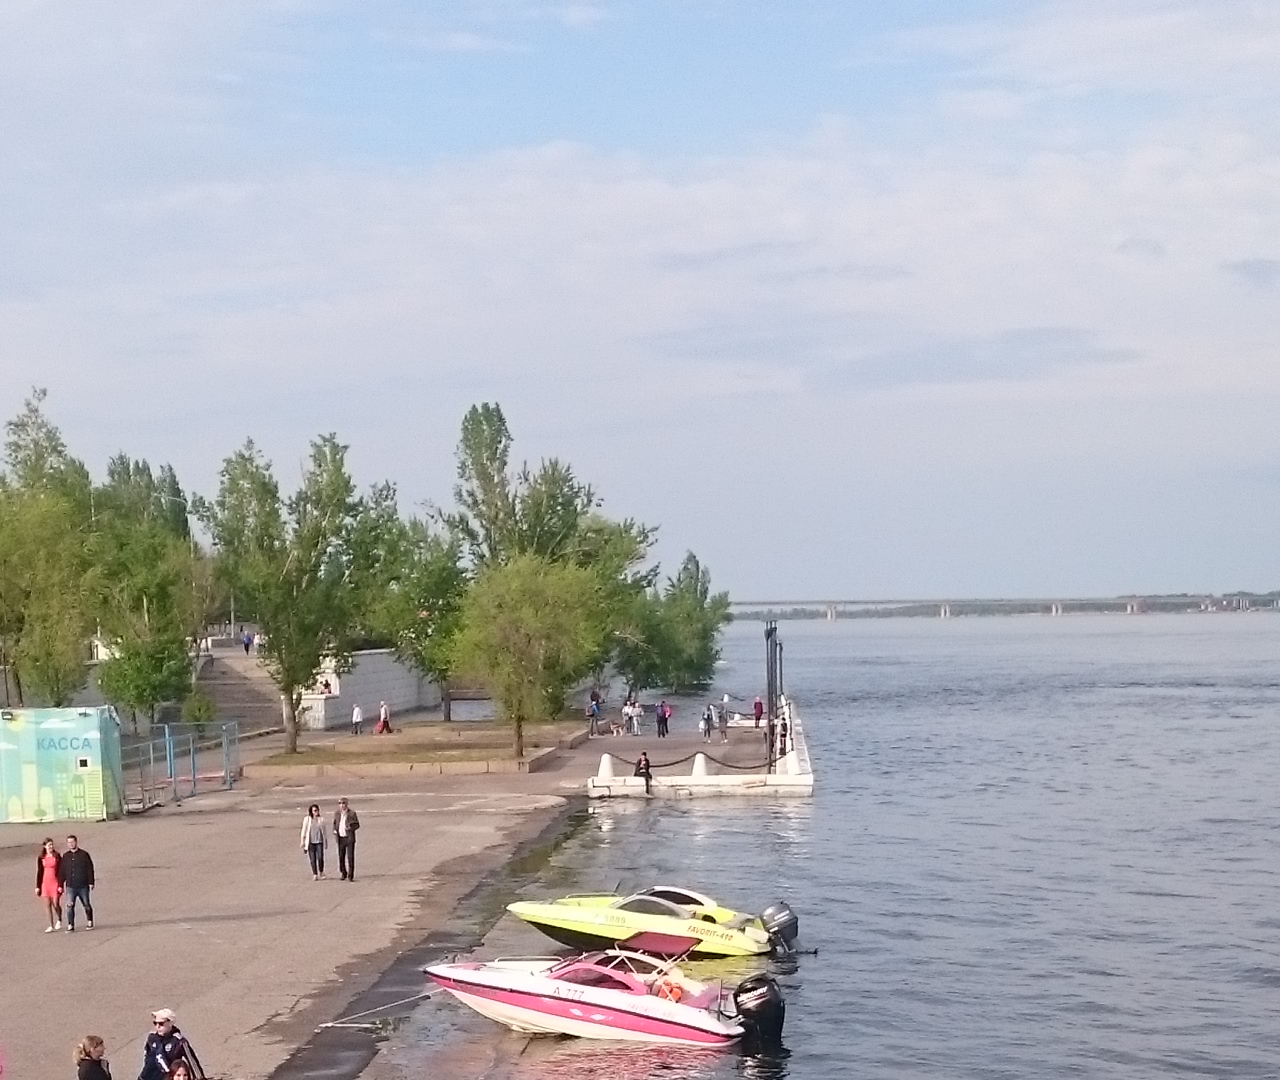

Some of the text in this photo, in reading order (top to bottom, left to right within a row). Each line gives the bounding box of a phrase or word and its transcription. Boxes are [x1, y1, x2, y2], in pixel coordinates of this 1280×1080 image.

[37, 737, 92, 750] КАССА
[687, 925, 734, 941] FAVORIT-490
[553, 986, 585, 1000] A 777
